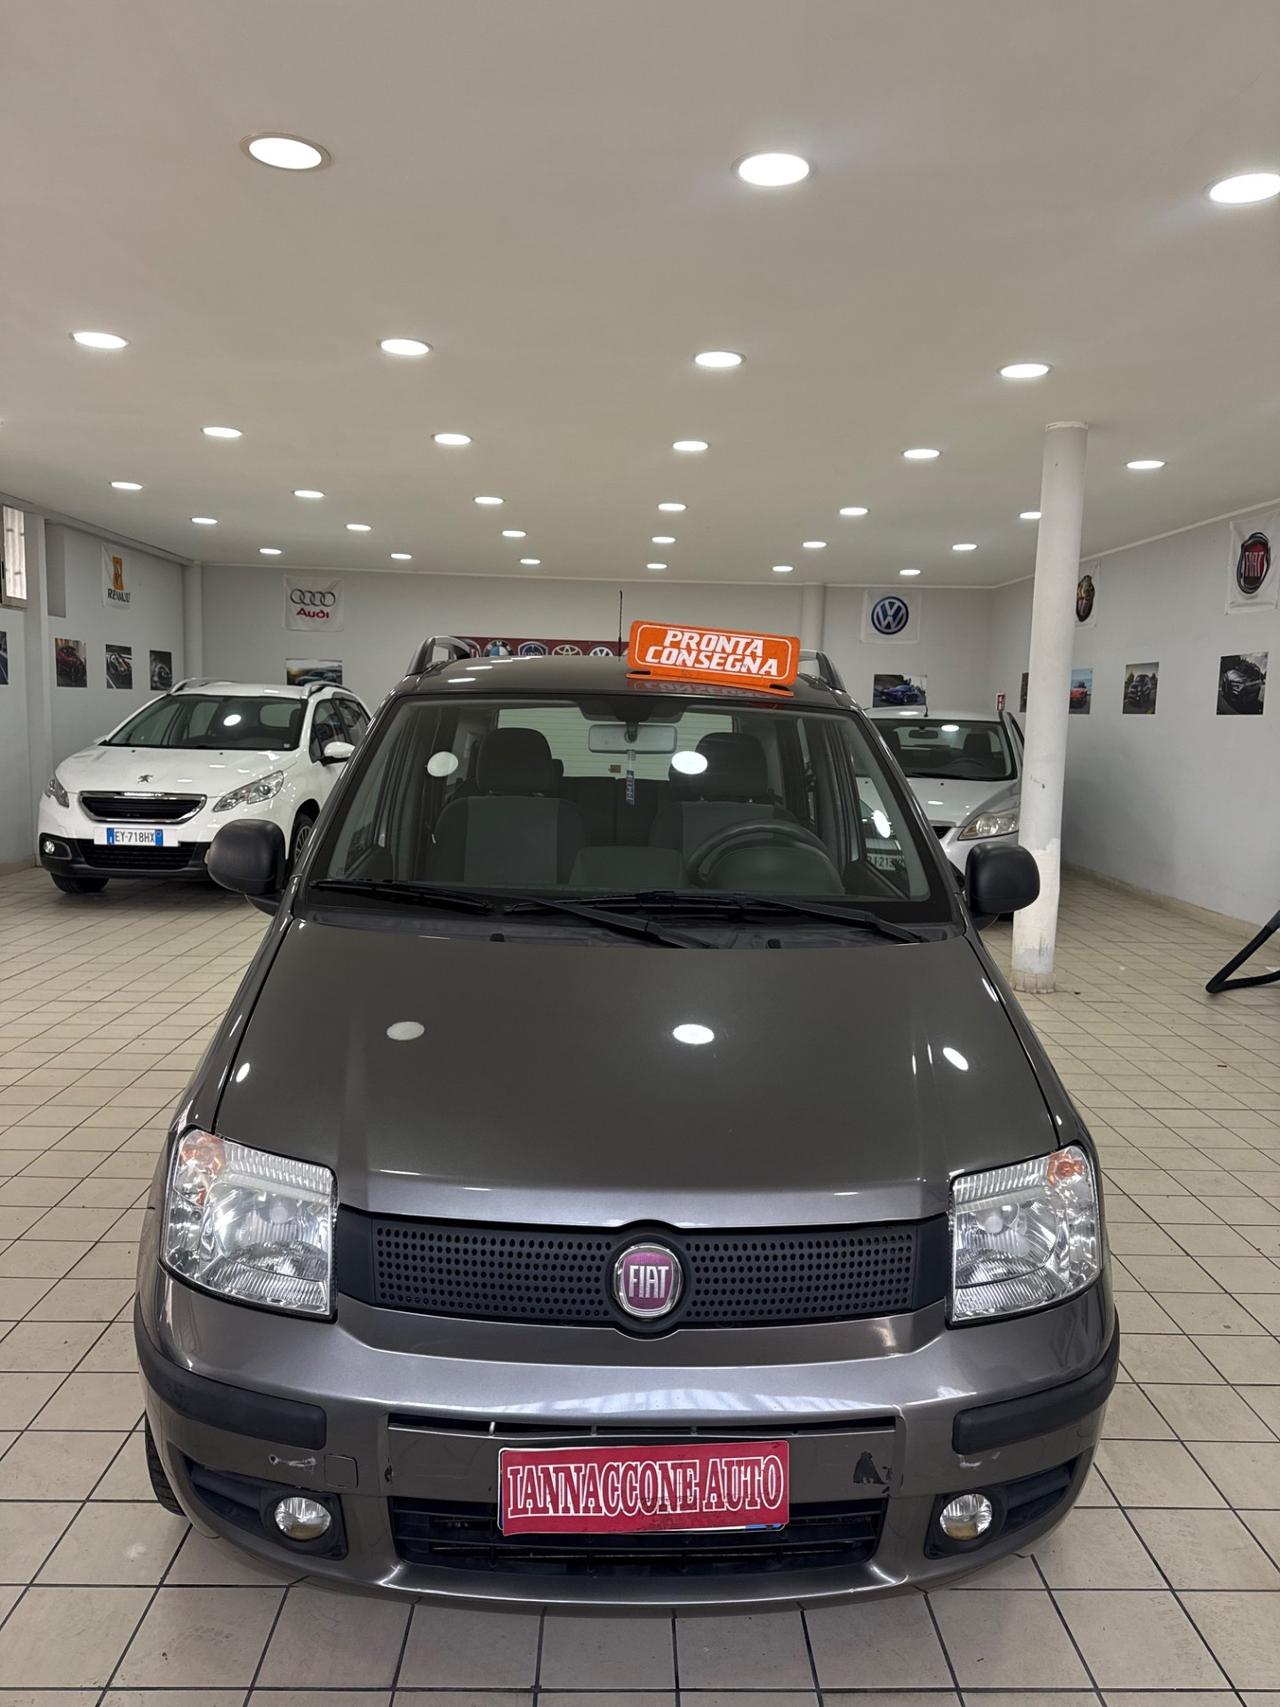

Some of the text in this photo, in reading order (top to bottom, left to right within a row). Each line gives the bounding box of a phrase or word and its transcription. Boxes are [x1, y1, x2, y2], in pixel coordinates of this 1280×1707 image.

[296, 607, 329, 619] Audi
[663, 629, 764, 657] PRONTA
[645, 645, 778, 676] CONSEGNA
[628, 1265, 669, 1298] FIAT
[508, 1455, 784, 1518] IANNACCONE AUTO
